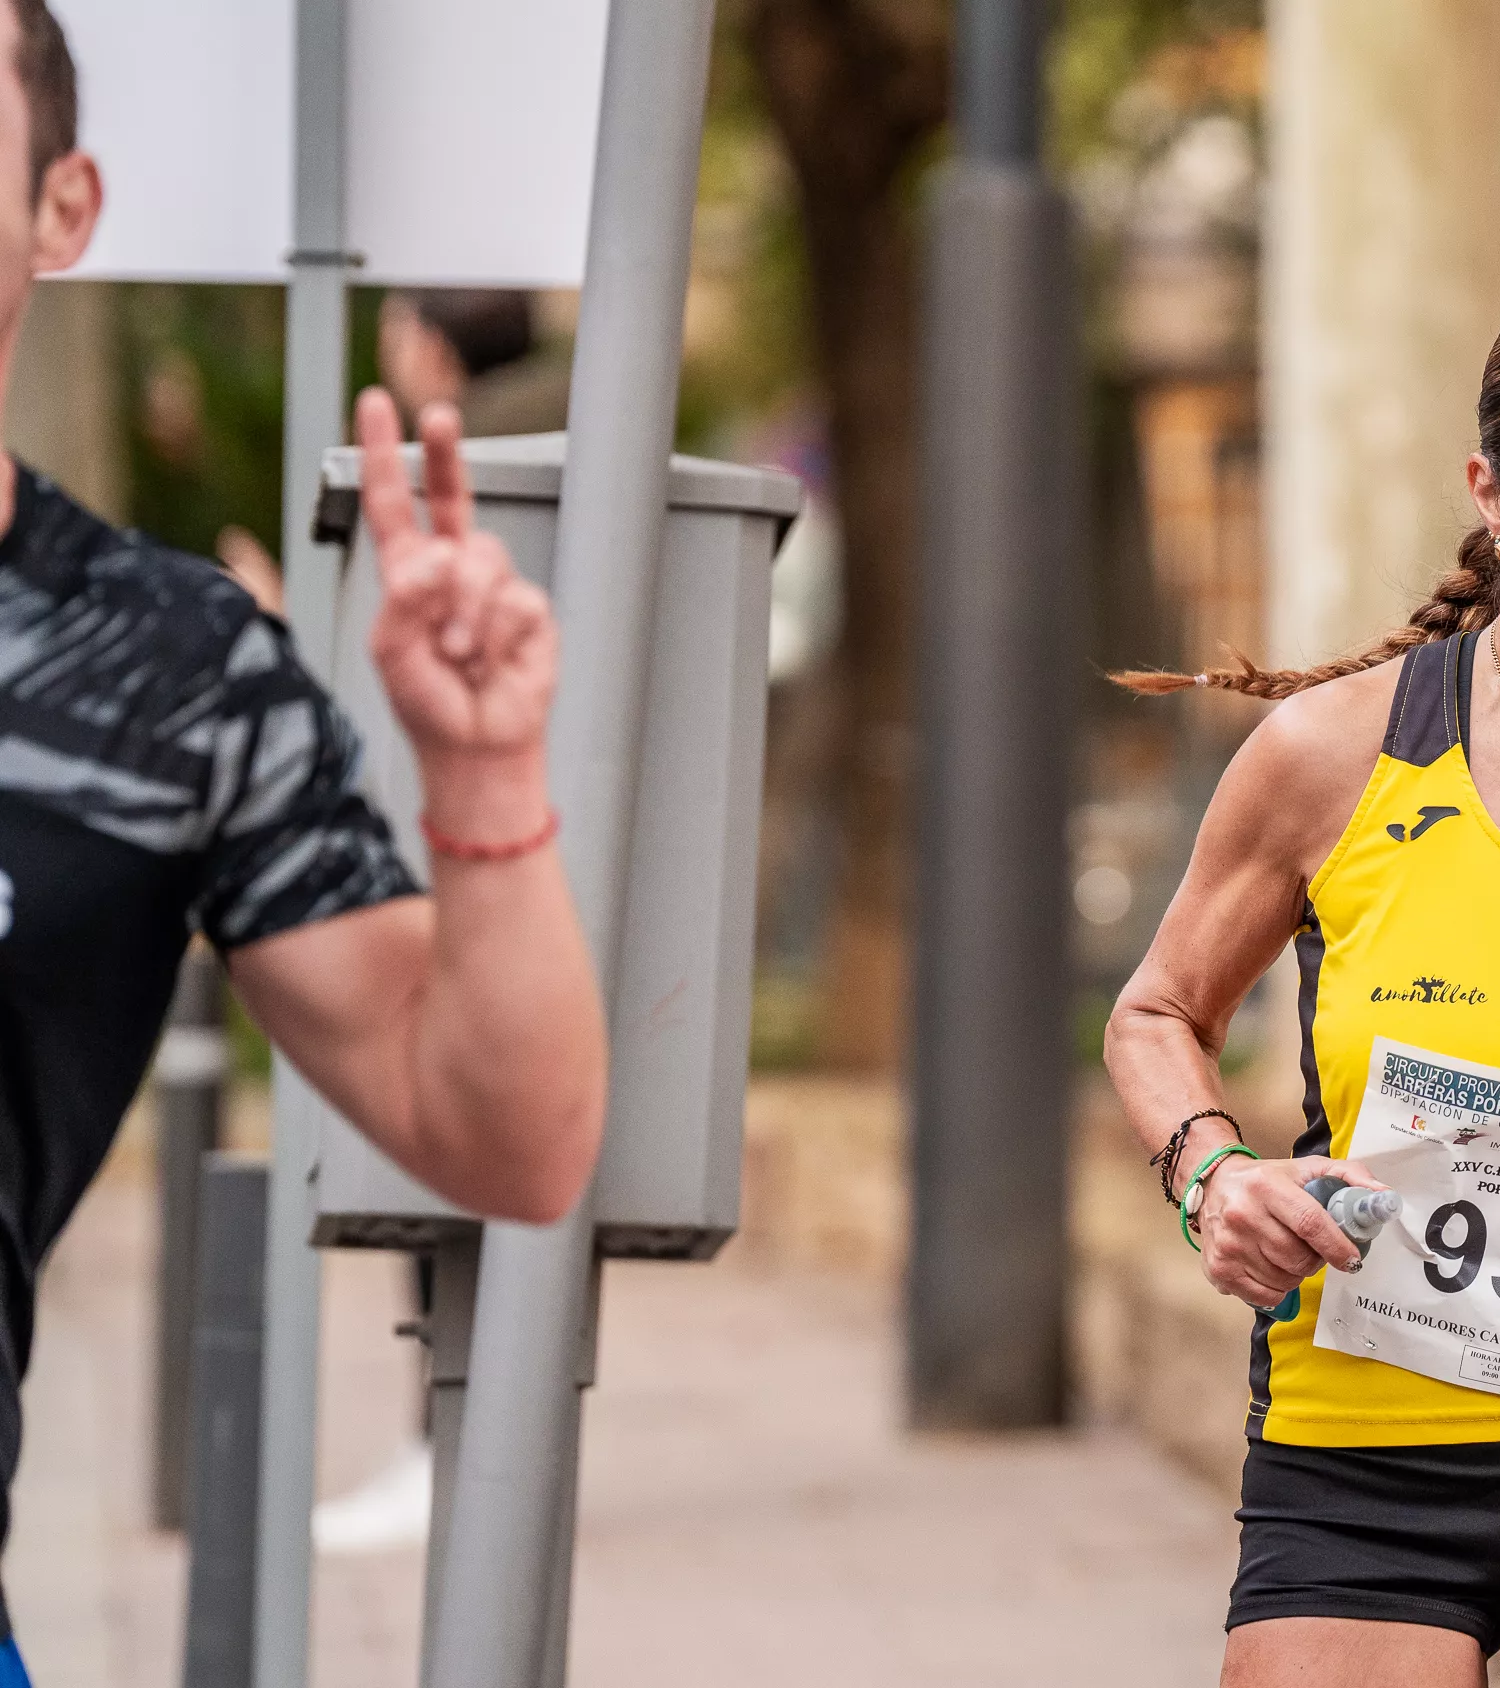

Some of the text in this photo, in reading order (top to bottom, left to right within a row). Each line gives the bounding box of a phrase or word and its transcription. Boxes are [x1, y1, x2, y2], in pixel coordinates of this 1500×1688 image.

[1384, 1054, 1454, 1086] CIRCUITO
[1382, 1068, 1468, 1107] CARRERAS
[1380, 1084, 1463, 1121] DIPUTACIÓN
[1471, 1113, 1490, 1126] DE
[1451, 1161, 1483, 1173] XXV
[1355, 1296, 1402, 1320] MARÍA
[1407, 1311, 1477, 1339] DOLORES
[1470, 1350, 1492, 1363] HORA
[1481, 1370, 1499, 1381] 09:00
